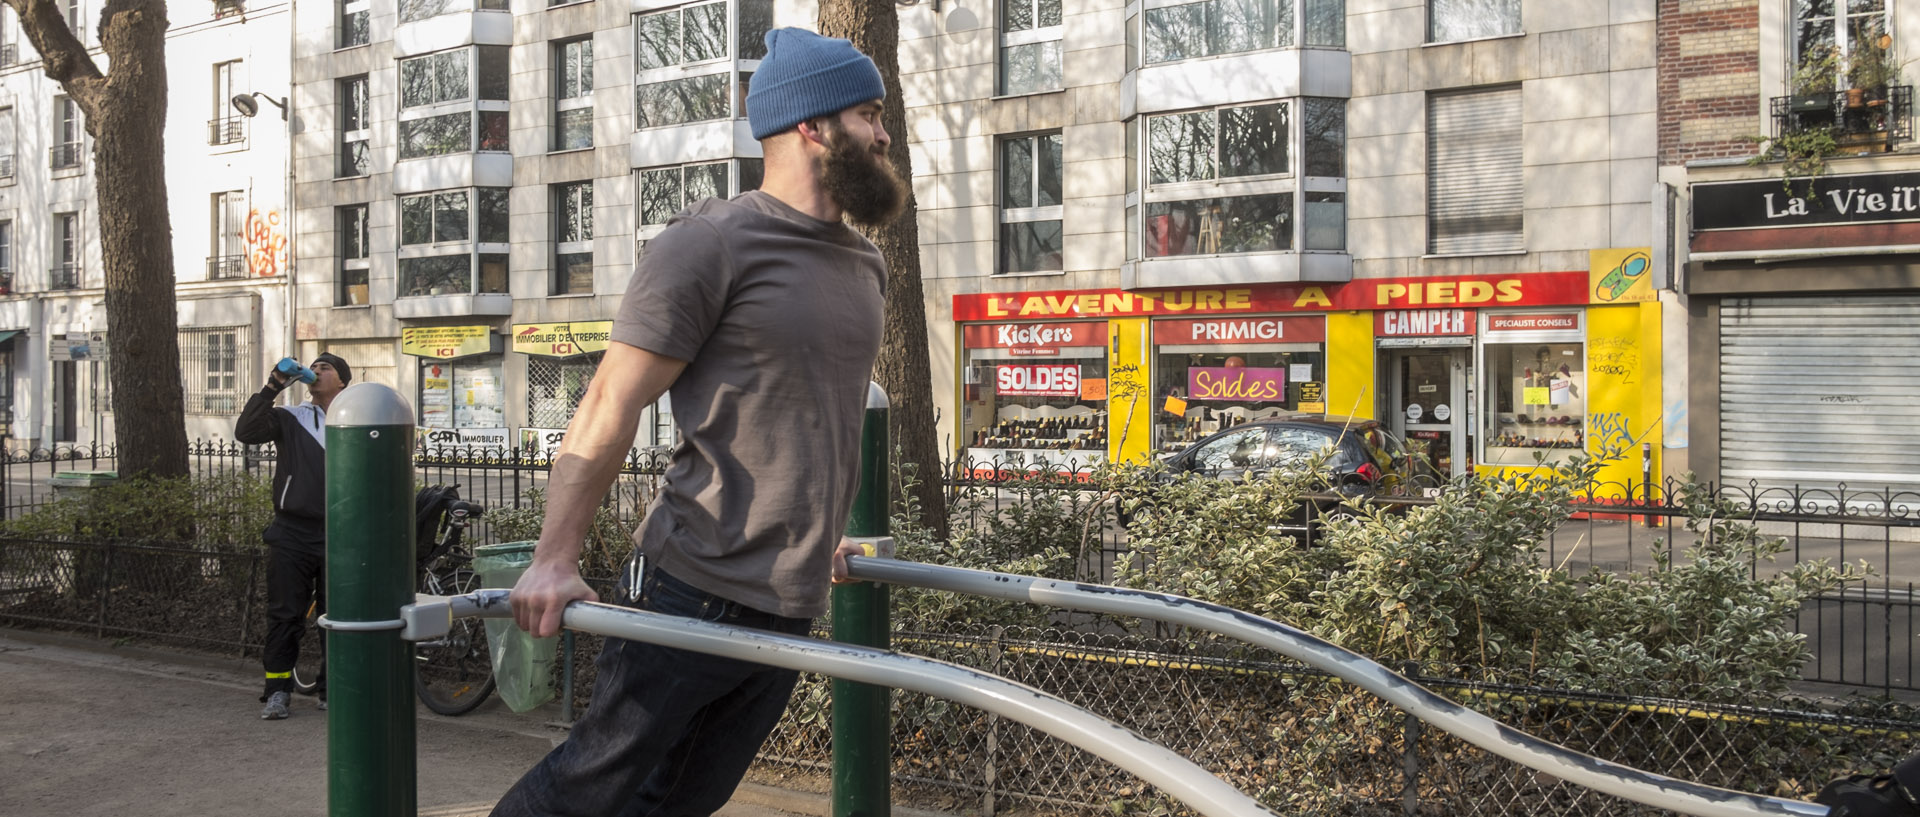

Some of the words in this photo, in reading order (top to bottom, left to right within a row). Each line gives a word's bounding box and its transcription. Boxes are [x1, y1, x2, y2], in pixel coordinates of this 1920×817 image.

[1763, 193, 1809, 218] La
[1826, 186, 1920, 215] Vieil
[987, 289, 1251, 317] L'AVENTURE
[1293, 286, 1332, 307] A
[1376, 279, 1523, 305] PIEDS
[1192, 320, 1284, 340] PRIMIGI
[1383, 309, 1465, 335] CAMPER
[1494, 319, 1536, 328] SPECIALISTE
[1537, 318, 1573, 327] CONSEILS
[515, 333, 557, 344] IMMOBILIER
[997, 324, 1073, 347] KicKers
[436, 348, 454, 357] ICI
[552, 343, 572, 354] ICI
[998, 366, 1078, 391] SOLDES
[1194, 371, 1278, 399] Soldes
[462, 435, 505, 444] IMMOBILIER
